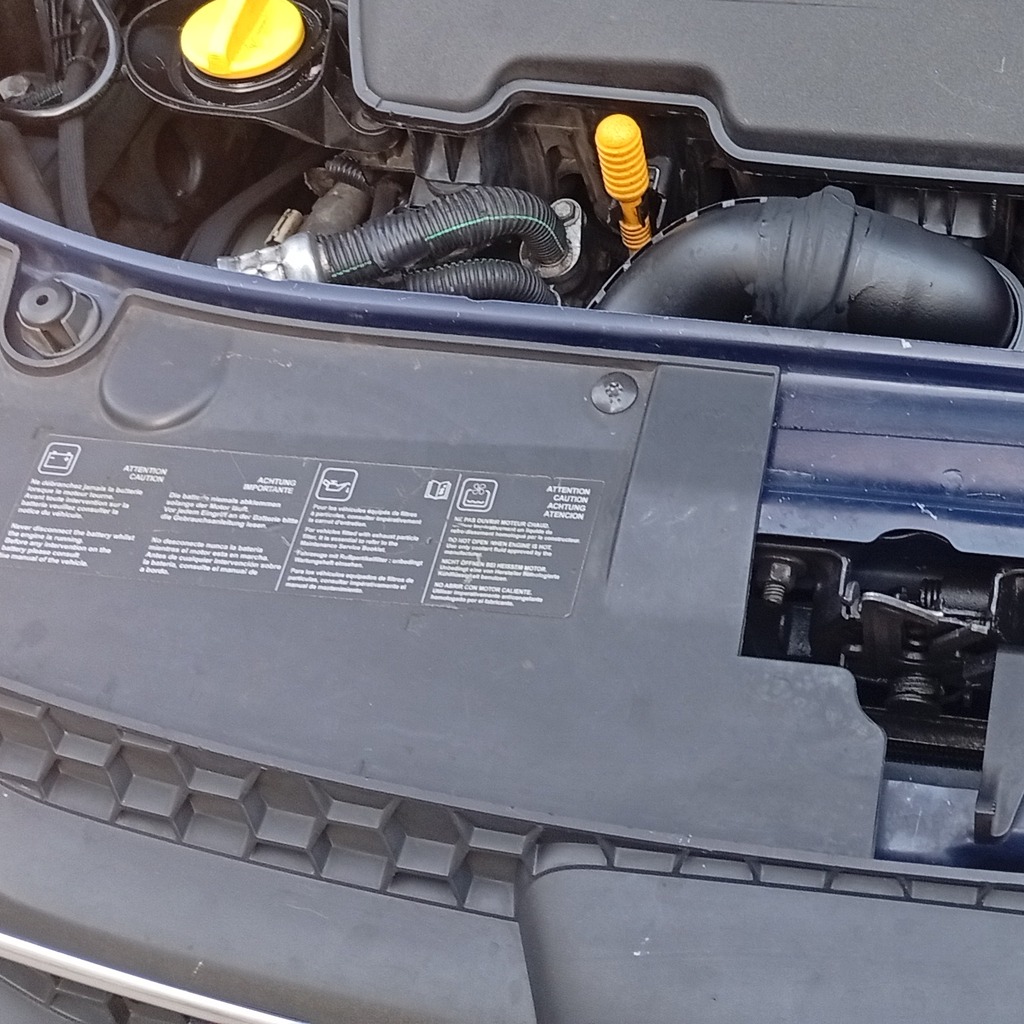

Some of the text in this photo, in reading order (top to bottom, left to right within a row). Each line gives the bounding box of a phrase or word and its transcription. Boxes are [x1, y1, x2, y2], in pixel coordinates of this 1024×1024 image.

[122, 464, 167, 475] ATTENTION
[128, 473, 164, 482] CAUTION
[256, 477, 297, 486] ACHTUNG
[242, 483, 294, 494] IMPORTANTE
[545, 485, 591, 494] ATTENTION
[552, 494, 589, 502] CAUTION
[546, 502, 587, 511] ACHTUNG
[542, 510, 585, 519] ATENCION
